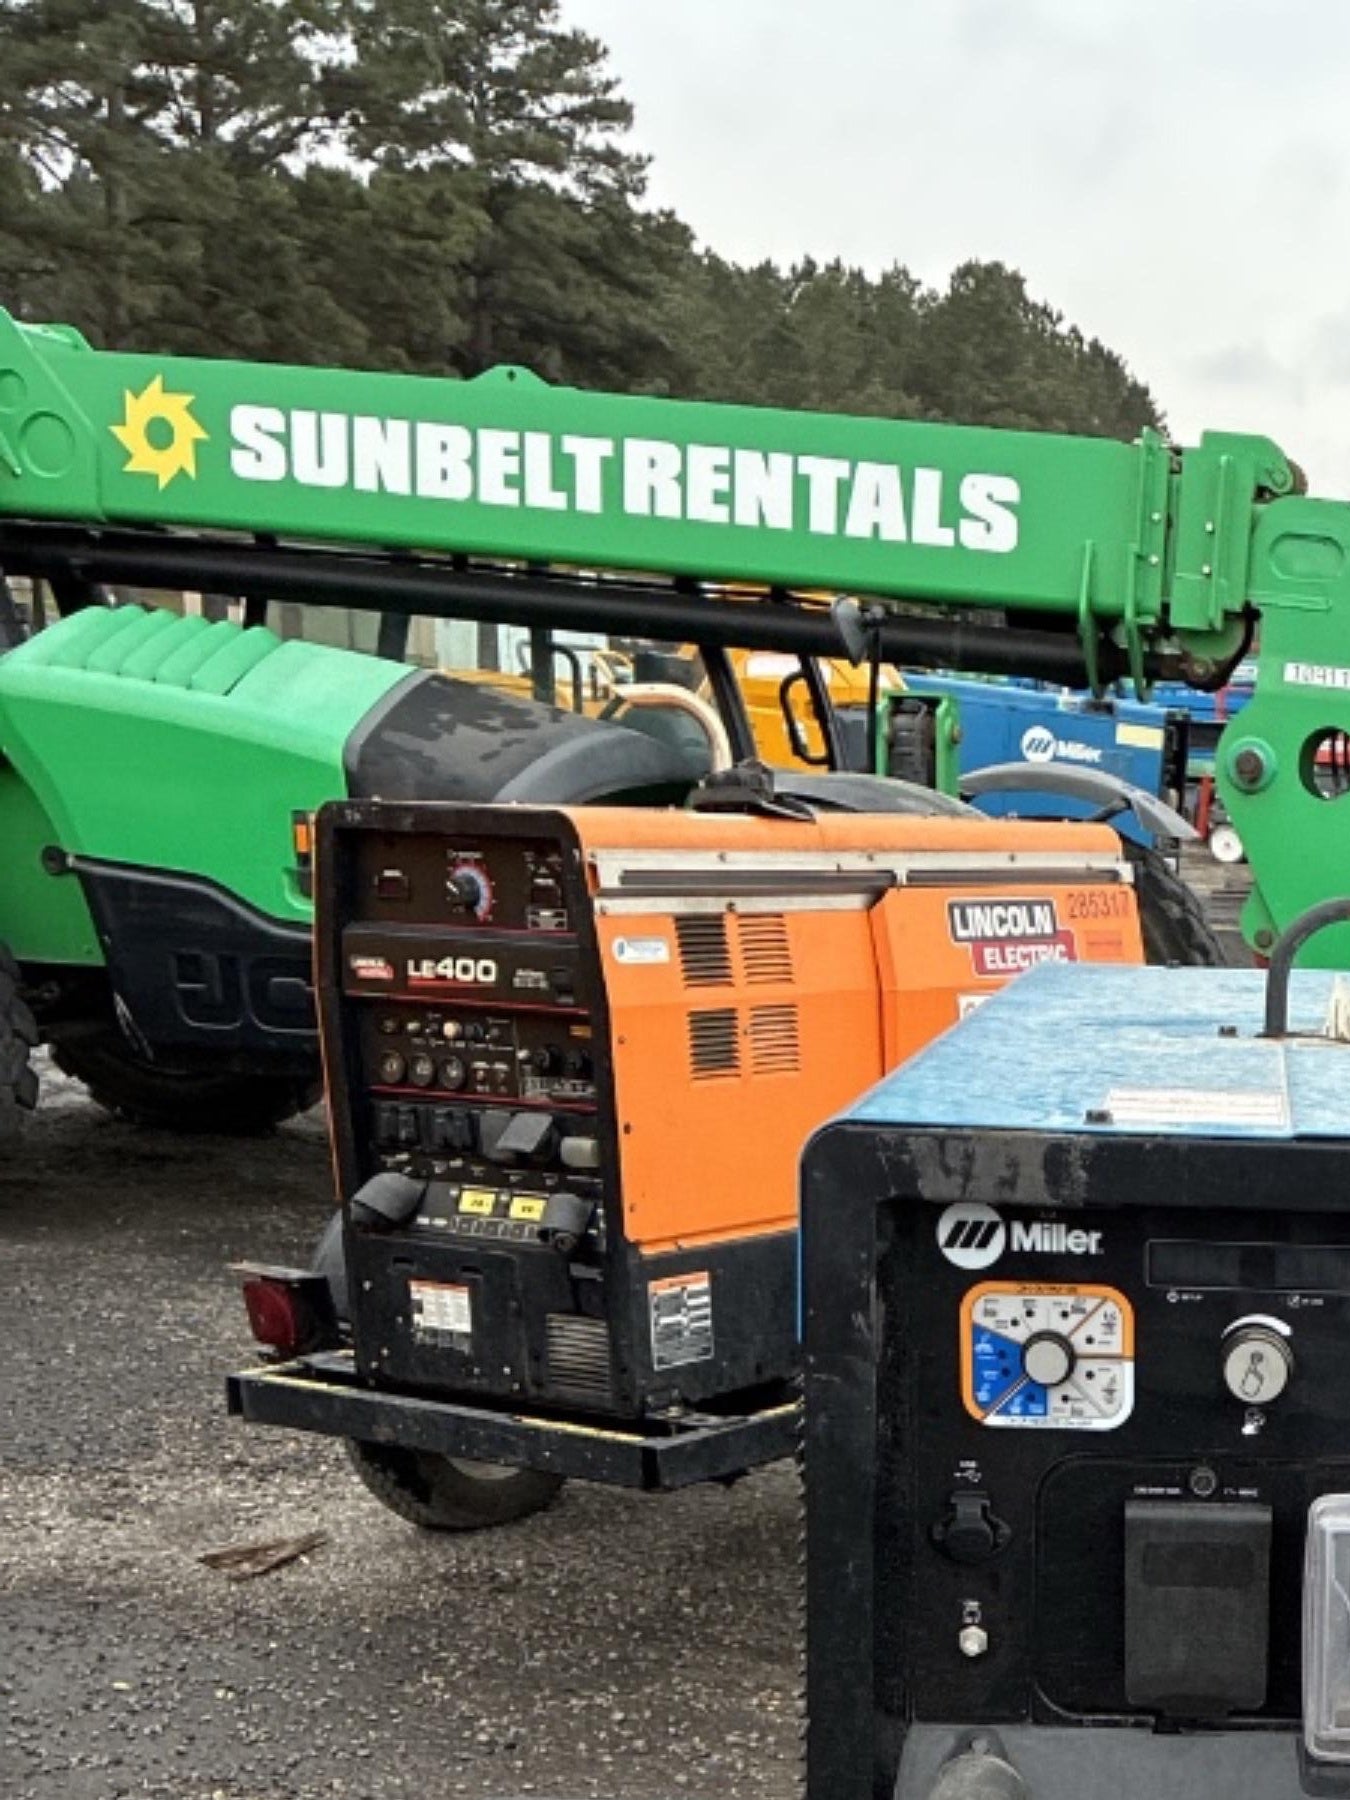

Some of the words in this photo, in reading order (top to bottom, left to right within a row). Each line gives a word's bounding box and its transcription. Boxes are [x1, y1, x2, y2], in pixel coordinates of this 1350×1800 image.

[230, 403, 613, 515] SUNBELT
[623, 437, 1021, 554] RENTALS
[952, 904, 1054, 938] LINCOLN
[1010, 1219, 1103, 1254] Miller
